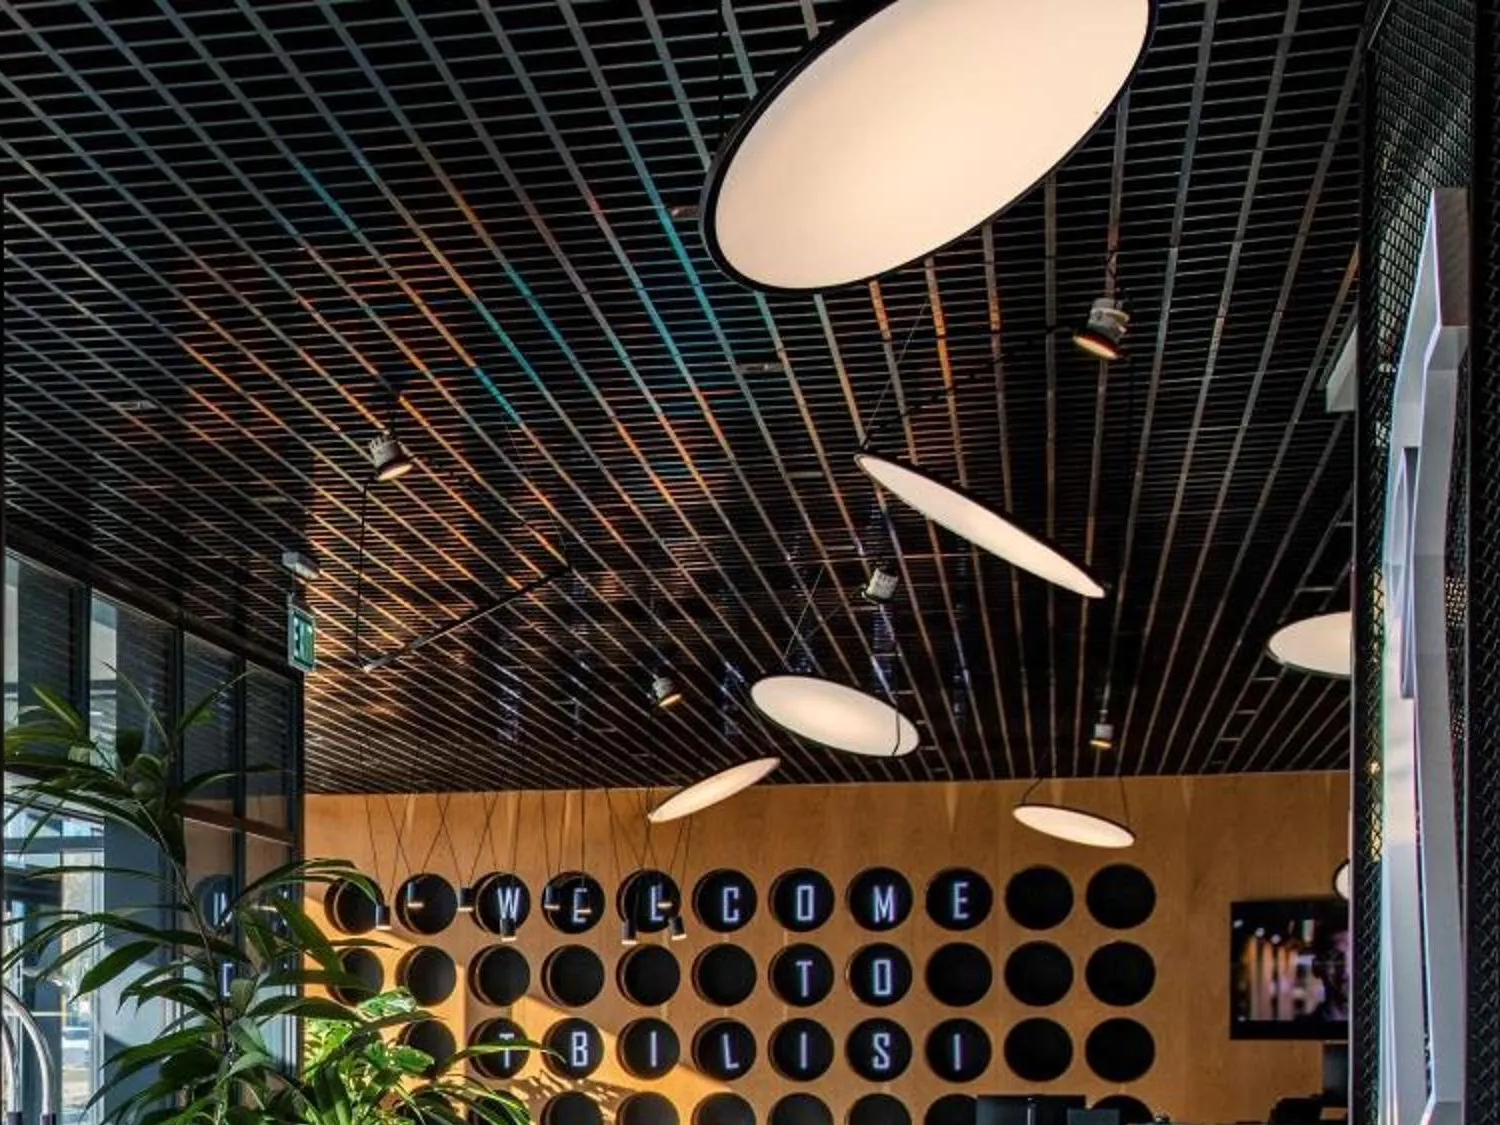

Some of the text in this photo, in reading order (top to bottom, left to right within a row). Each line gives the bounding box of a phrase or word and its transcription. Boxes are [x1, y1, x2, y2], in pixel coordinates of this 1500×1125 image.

[497, 882, 969, 923] WELCOME
[795, 959, 892, 998] TO
[499, 1031, 962, 1071] TBILISI
